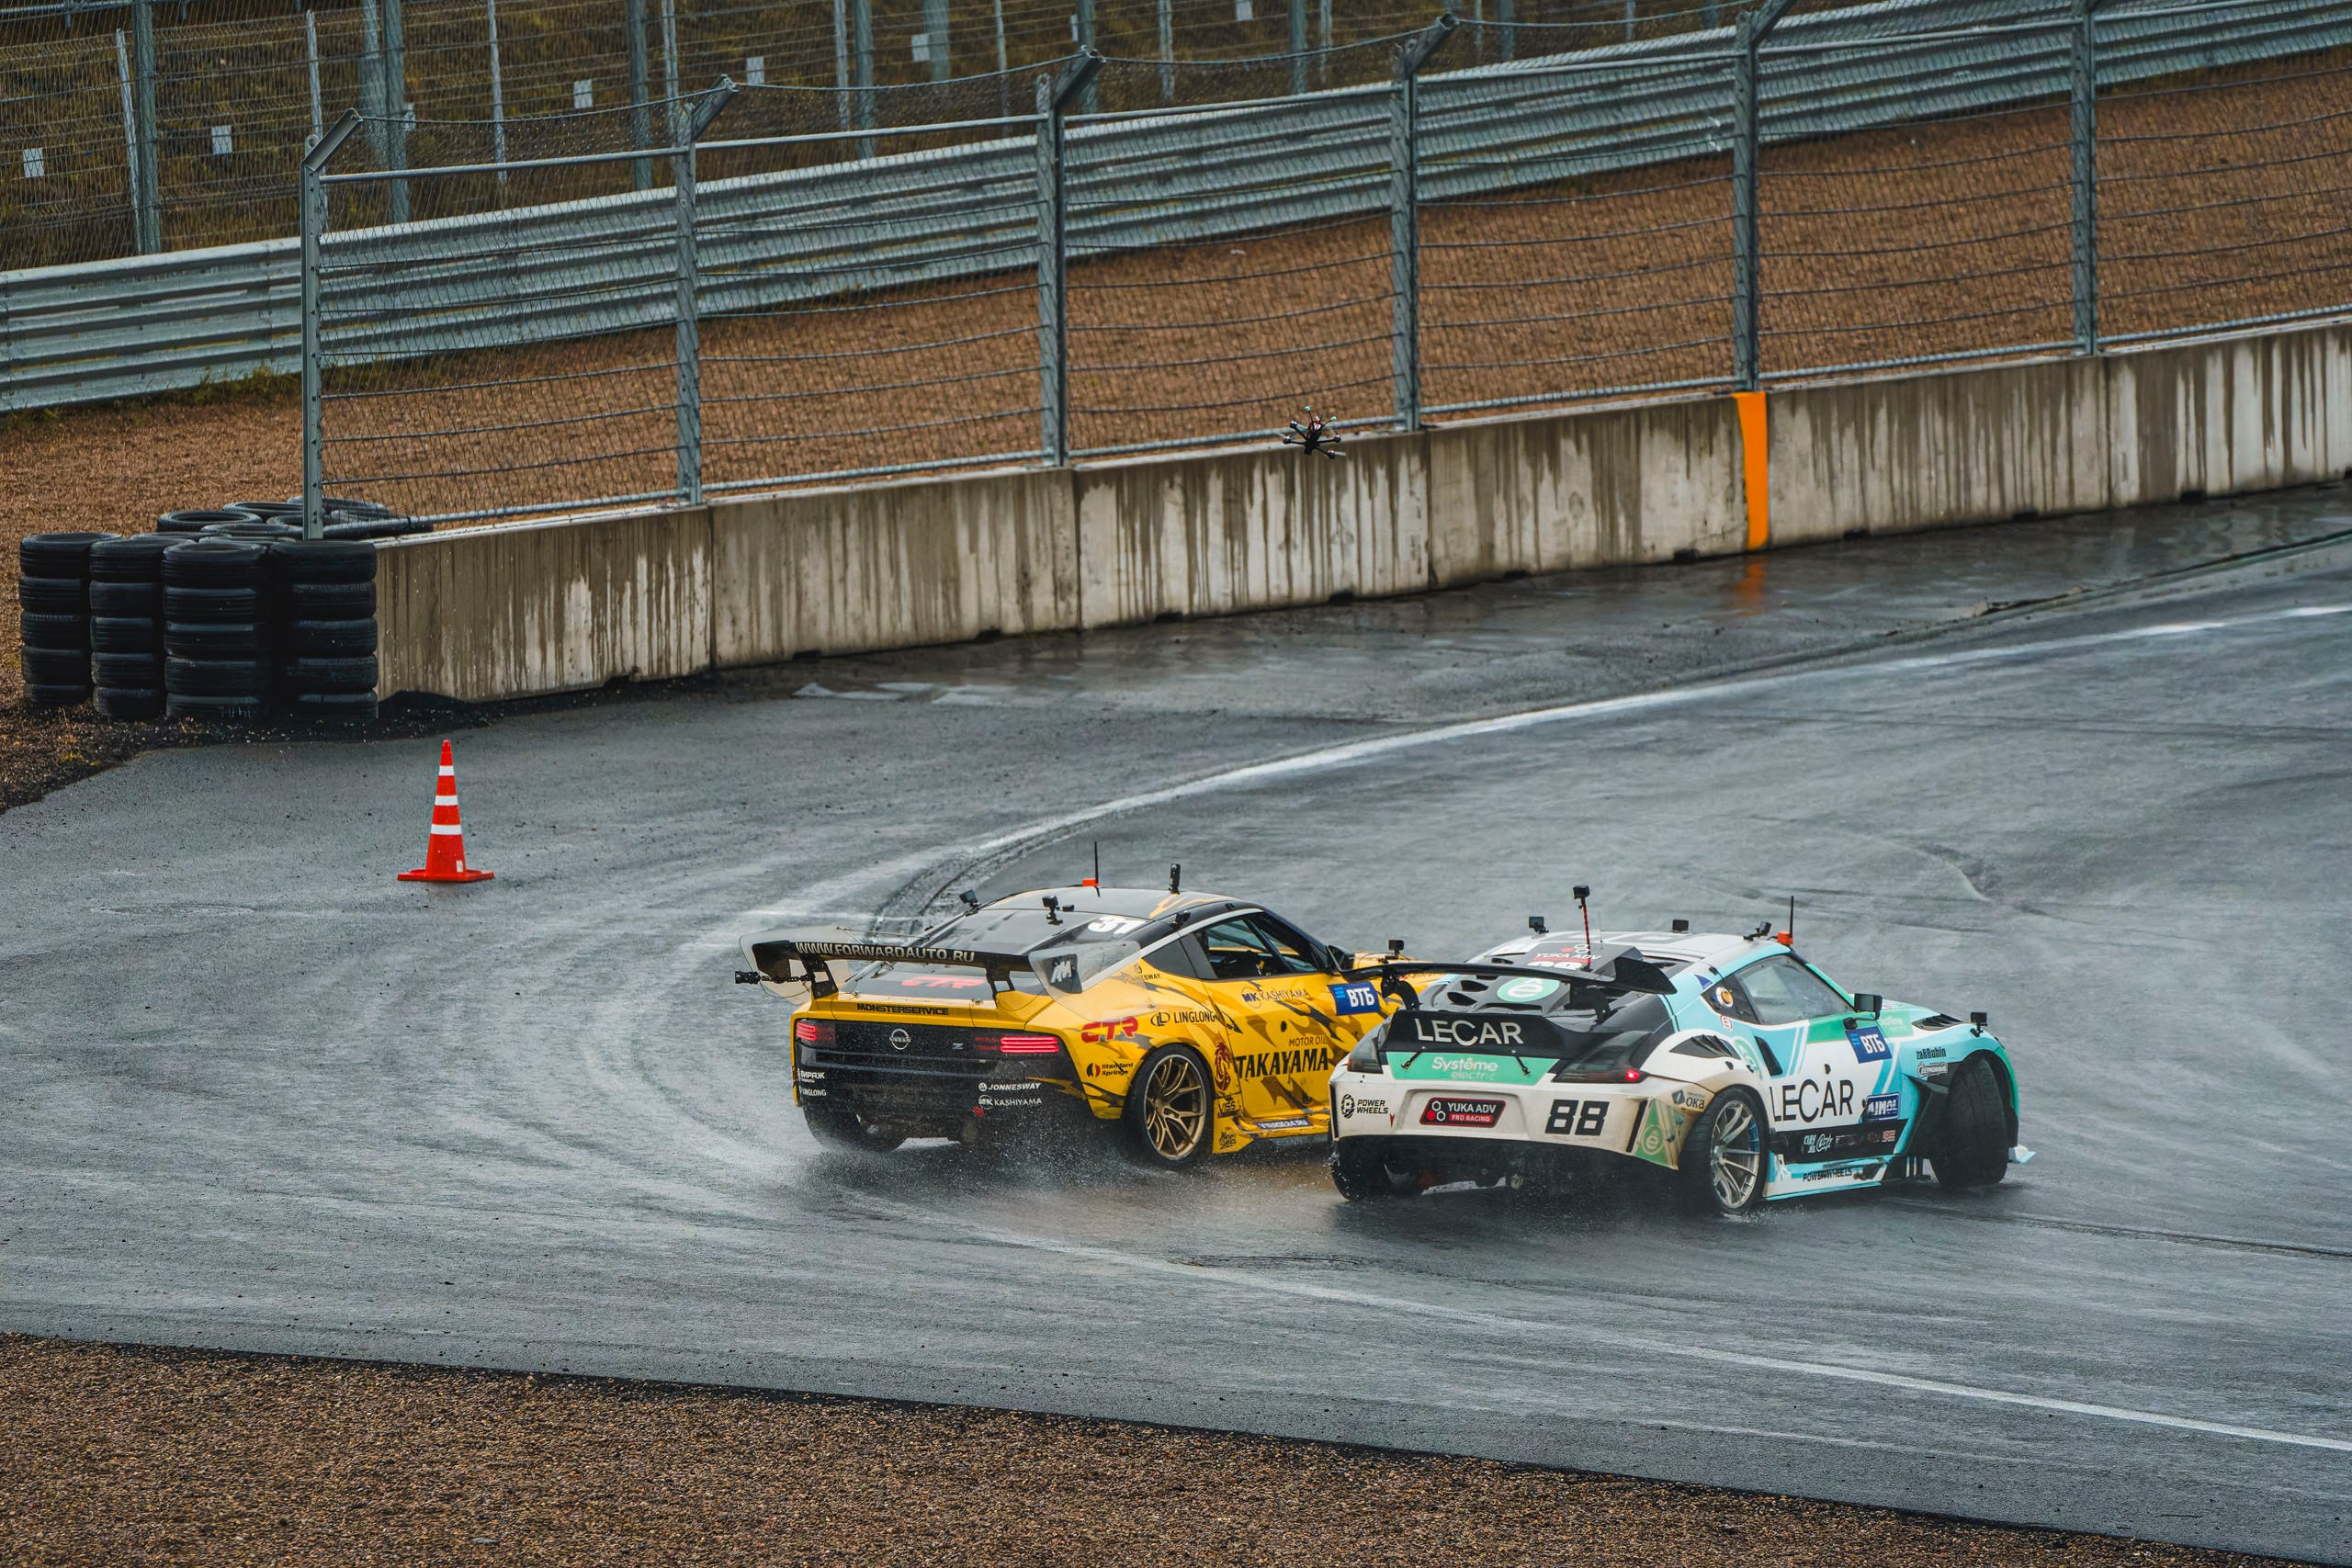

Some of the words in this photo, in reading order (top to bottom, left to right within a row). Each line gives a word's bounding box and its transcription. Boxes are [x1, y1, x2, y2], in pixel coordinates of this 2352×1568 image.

[796, 942, 975, 963] WWW.FORWARDAUTO.RU
[1260, 988, 1309, 1001] KASHIYAMA
[1346, 987, 1375, 1008] ВТБ
[856, 1003, 950, 1016] MONSTERSERVICE
[1173, 1010, 1216, 1024] LINGLONG
[1080, 1016, 1138, 1043] CTR
[1414, 1018, 1525, 1046] LECAR
[1288, 1038, 1314, 1047] MOTOR
[1860, 1032, 1885, 1055] ВТБ
[1235, 1047, 1329, 1079] TAKAYAMA
[988, 1083, 1041, 1091] JONNESWAY
[994, 1098, 1043, 1107] KASHIYAMA
[1357, 1099, 1385, 1107] POWER
[1447, 1102, 1475, 1113] YUKA
[1476, 1103, 1497, 1113] ADV
[1769, 1078, 1854, 1122] LECAR
[1544, 1099, 1610, 1136] 88
